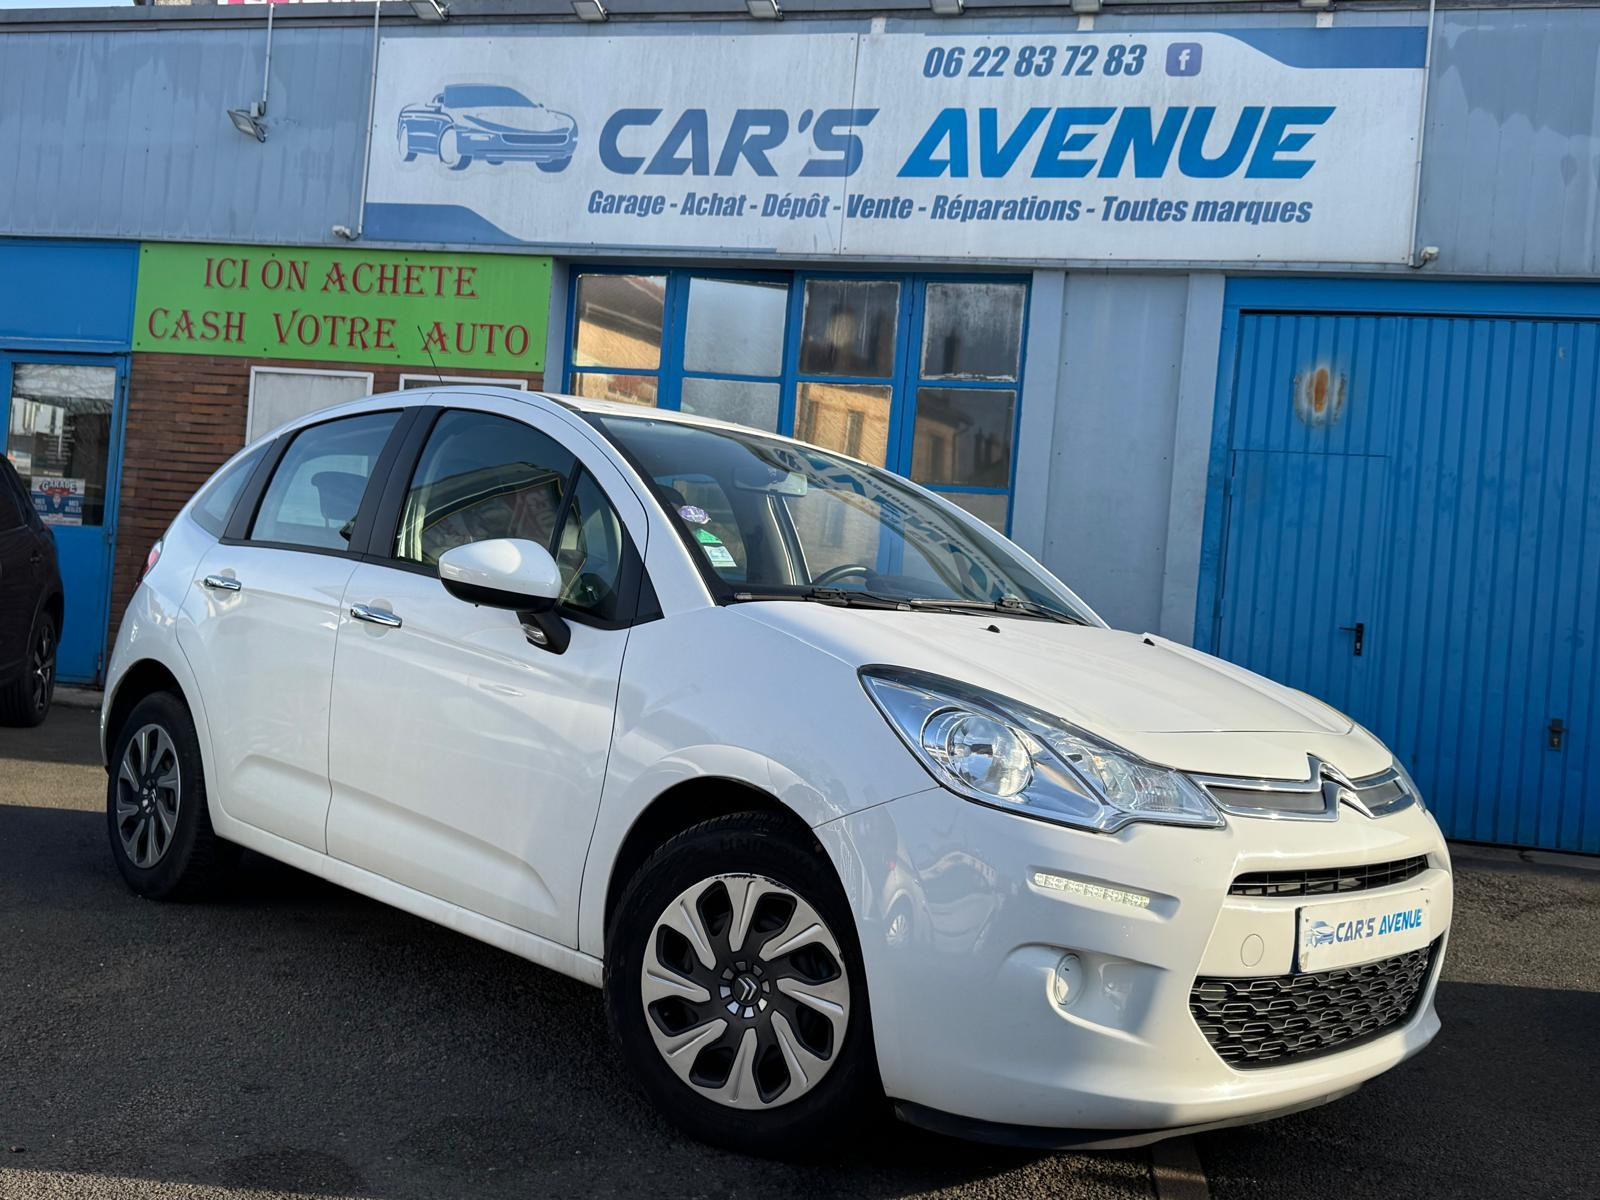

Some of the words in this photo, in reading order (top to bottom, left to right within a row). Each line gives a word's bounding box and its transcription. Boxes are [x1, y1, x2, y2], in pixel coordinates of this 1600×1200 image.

[922, 46, 966, 79] 06
[967, 45, 1011, 78] 22
[1013, 44, 1057, 78] 83
[1060, 44, 1100, 77] 72
[1102, 43, 1148, 77] 83
[597, 107, 881, 177] CAR'S
[895, 104, 1338, 181] AVENUE
[587, 190, 666, 218] Garage
[680, 191, 748, 217] Achat
[761, 192, 831, 220] Dépôt
[847, 194, 914, 219] Vente
[930, 194, 1082, 223] Réparations
[1102, 196, 1190, 222] Toutes
[1191, 199, 1313, 225] marques
[204, 257, 249, 289] ICI
[261, 259, 309, 292] ON
[321, 262, 478, 299] ACHETE
[148, 308, 247, 342] CASH
[273, 309, 397, 351] VOTRE
[420, 321, 530, 357] AUTO
[1335, 917, 1376, 942] CAR'S
[1378, 908, 1423, 935] AVENUE
